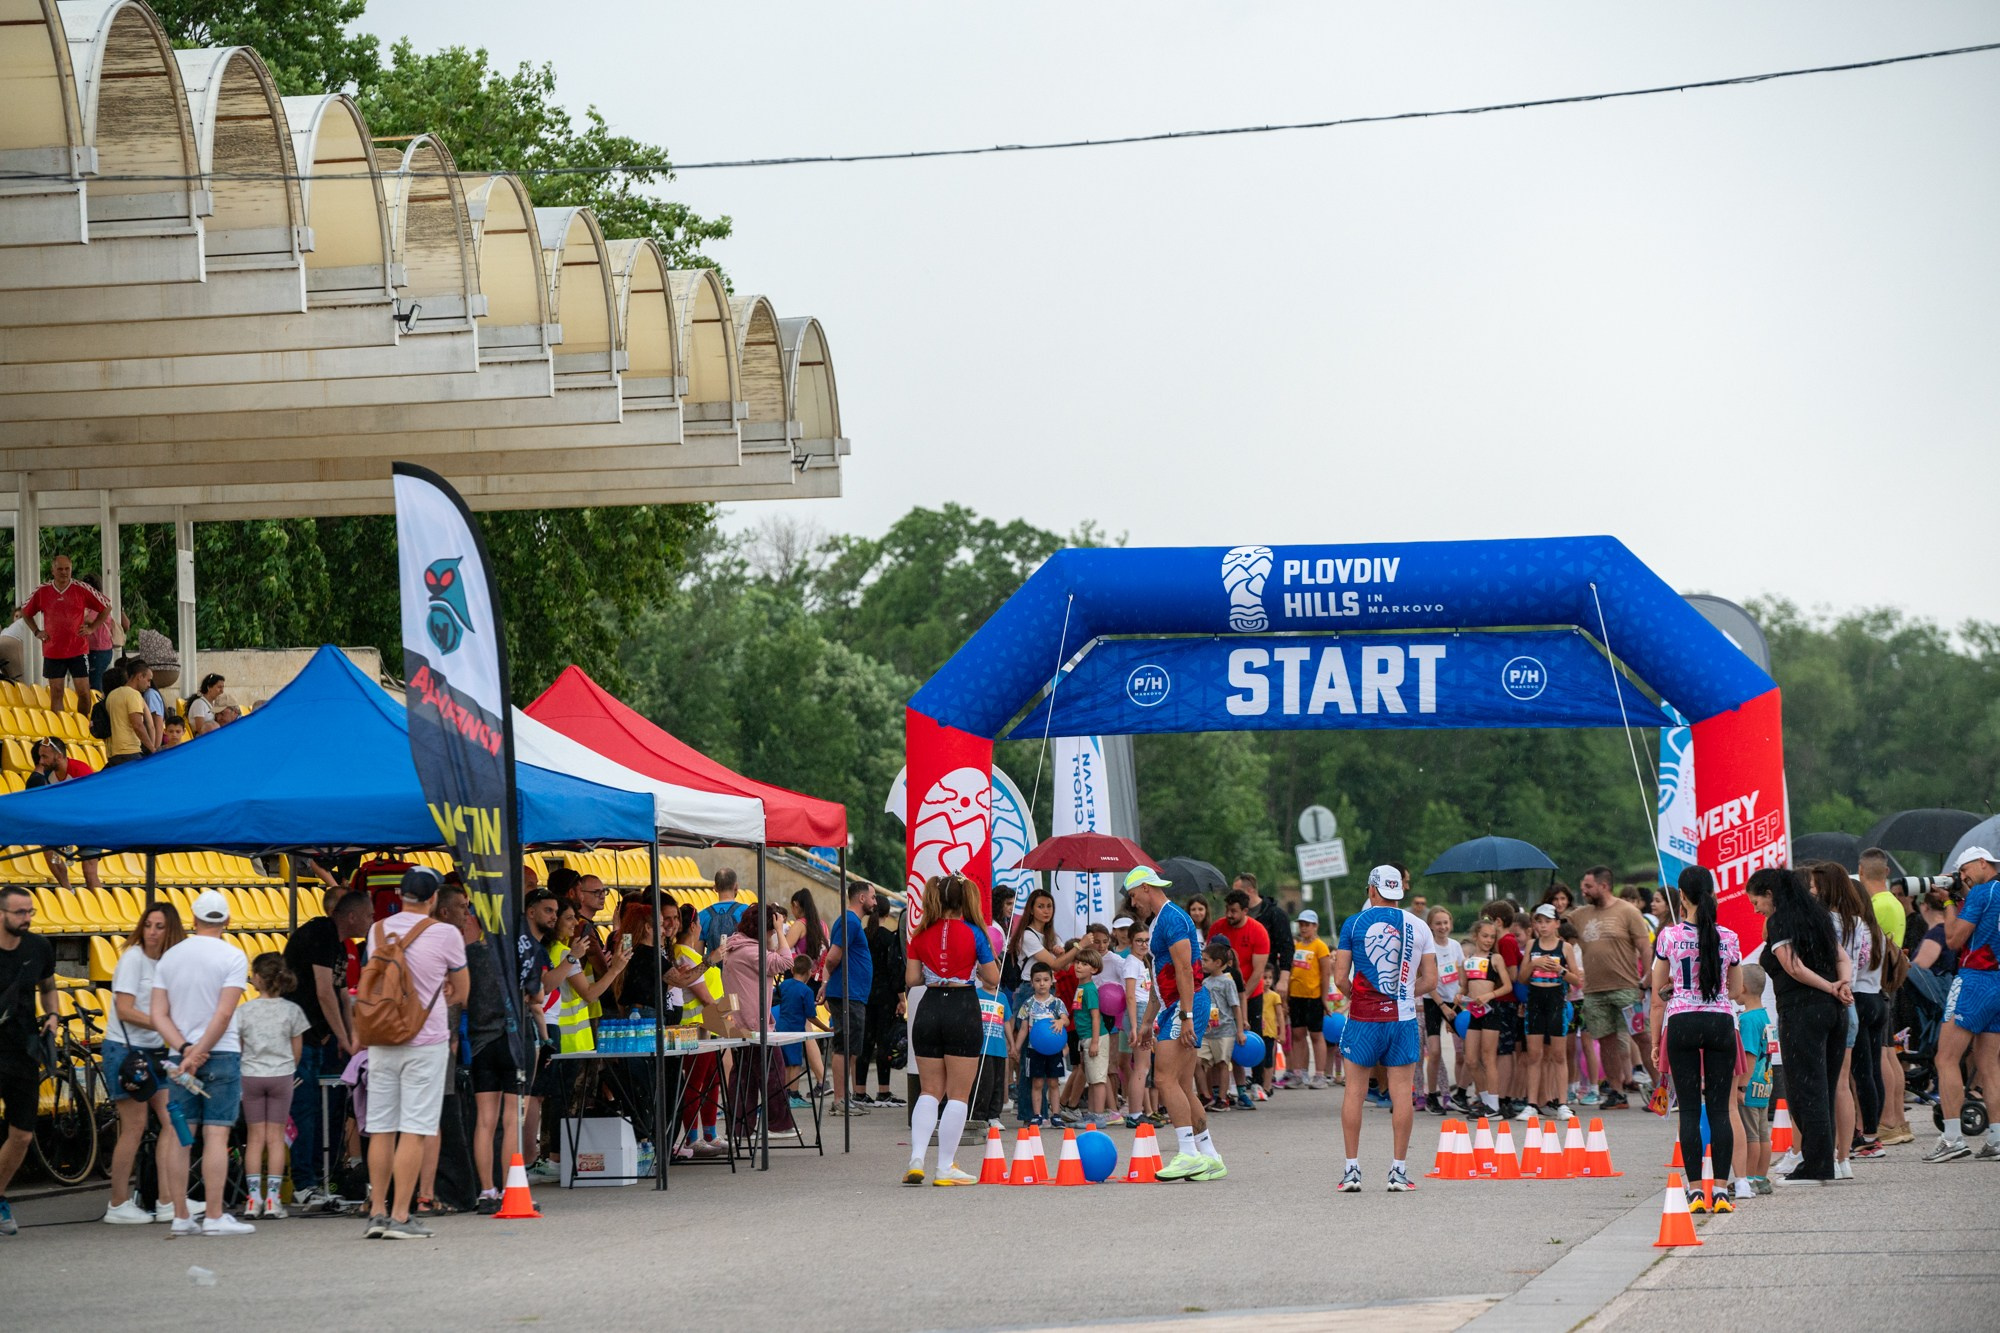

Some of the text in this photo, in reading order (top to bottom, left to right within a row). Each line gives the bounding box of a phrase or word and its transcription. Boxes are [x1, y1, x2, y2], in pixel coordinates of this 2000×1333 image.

[1283, 557, 1400, 585] PLOVDIV
[1284, 591, 1360, 617] HILLS
[1368, 594, 1383, 603] IN
[1368, 604, 1444, 614] MARKOVO
[1134, 676, 1162, 691] P/H
[1226, 644, 1446, 716] START
[1509, 670, 1539, 684] P/H
[1696, 790, 1759, 841] VERY
[1718, 809, 1780, 862] STEP
[1709, 834, 1787, 894] ATTERS
[1404, 922, 1414, 962] MATTERS
[1401, 960, 1410, 984] STEP
